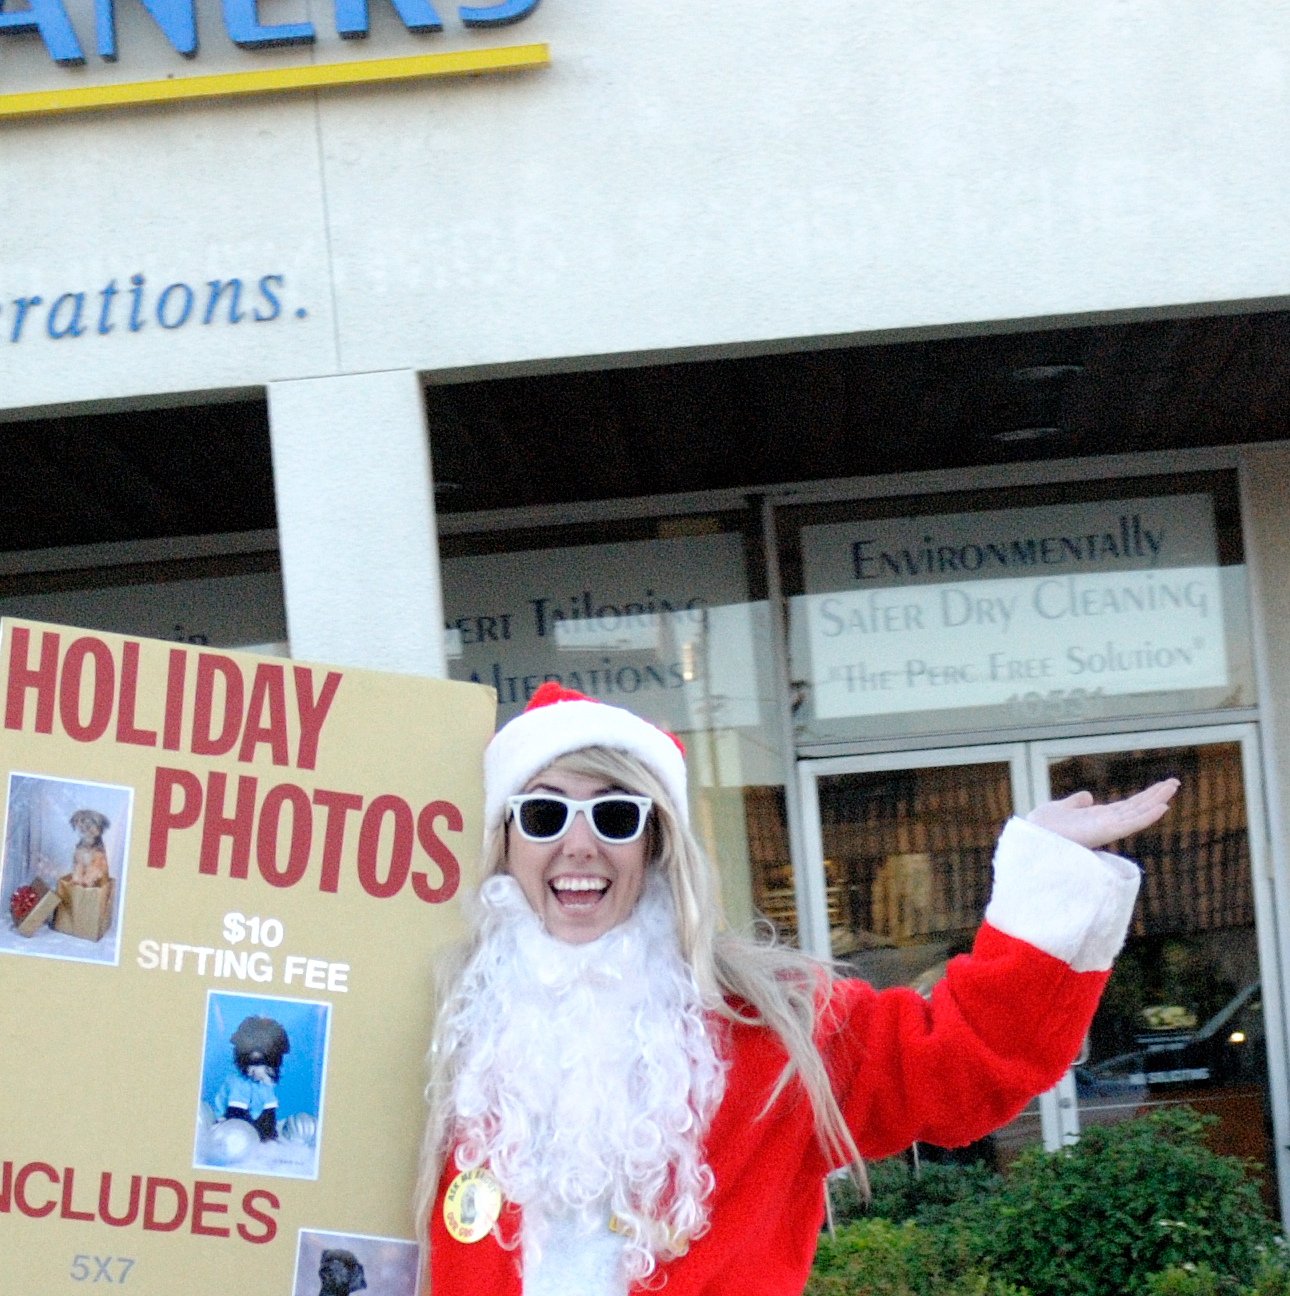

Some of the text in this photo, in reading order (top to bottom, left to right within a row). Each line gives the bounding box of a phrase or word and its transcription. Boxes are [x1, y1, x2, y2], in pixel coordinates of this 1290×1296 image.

[4, 627, 343, 770] HOLIDAY
[147, 766, 464, 904] PHOTOS
[222, 912, 284, 948] $10
[136, 939, 350, 994] SITTING FEE
[69, 1255, 136, 1286] 5X7
